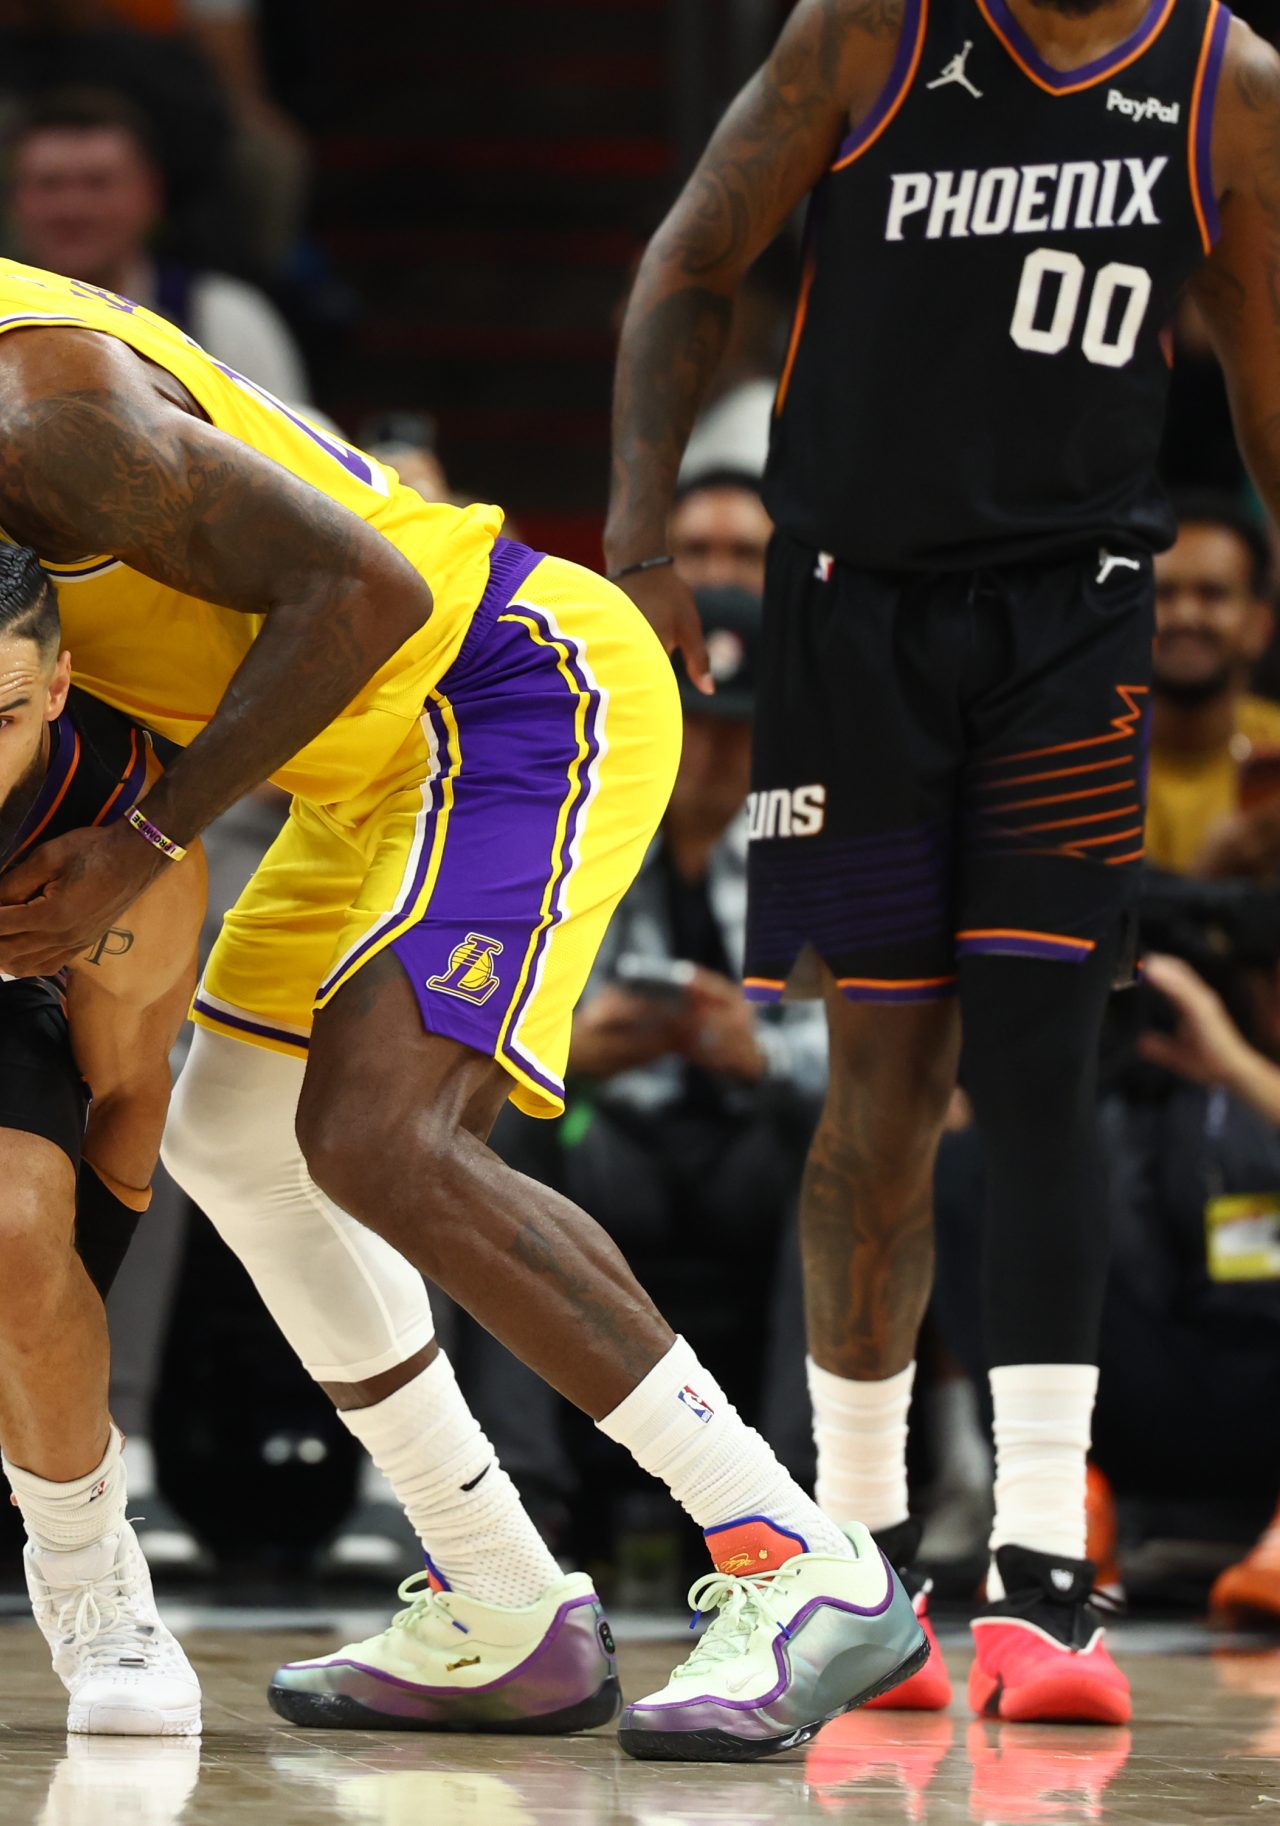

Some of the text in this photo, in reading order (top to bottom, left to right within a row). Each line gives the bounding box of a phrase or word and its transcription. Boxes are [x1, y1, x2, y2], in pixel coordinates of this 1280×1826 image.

[1106, 89, 1180, 124] PayPal
[885, 156, 1168, 241] PHOENIX
[1010, 247, 1151, 367] 00
